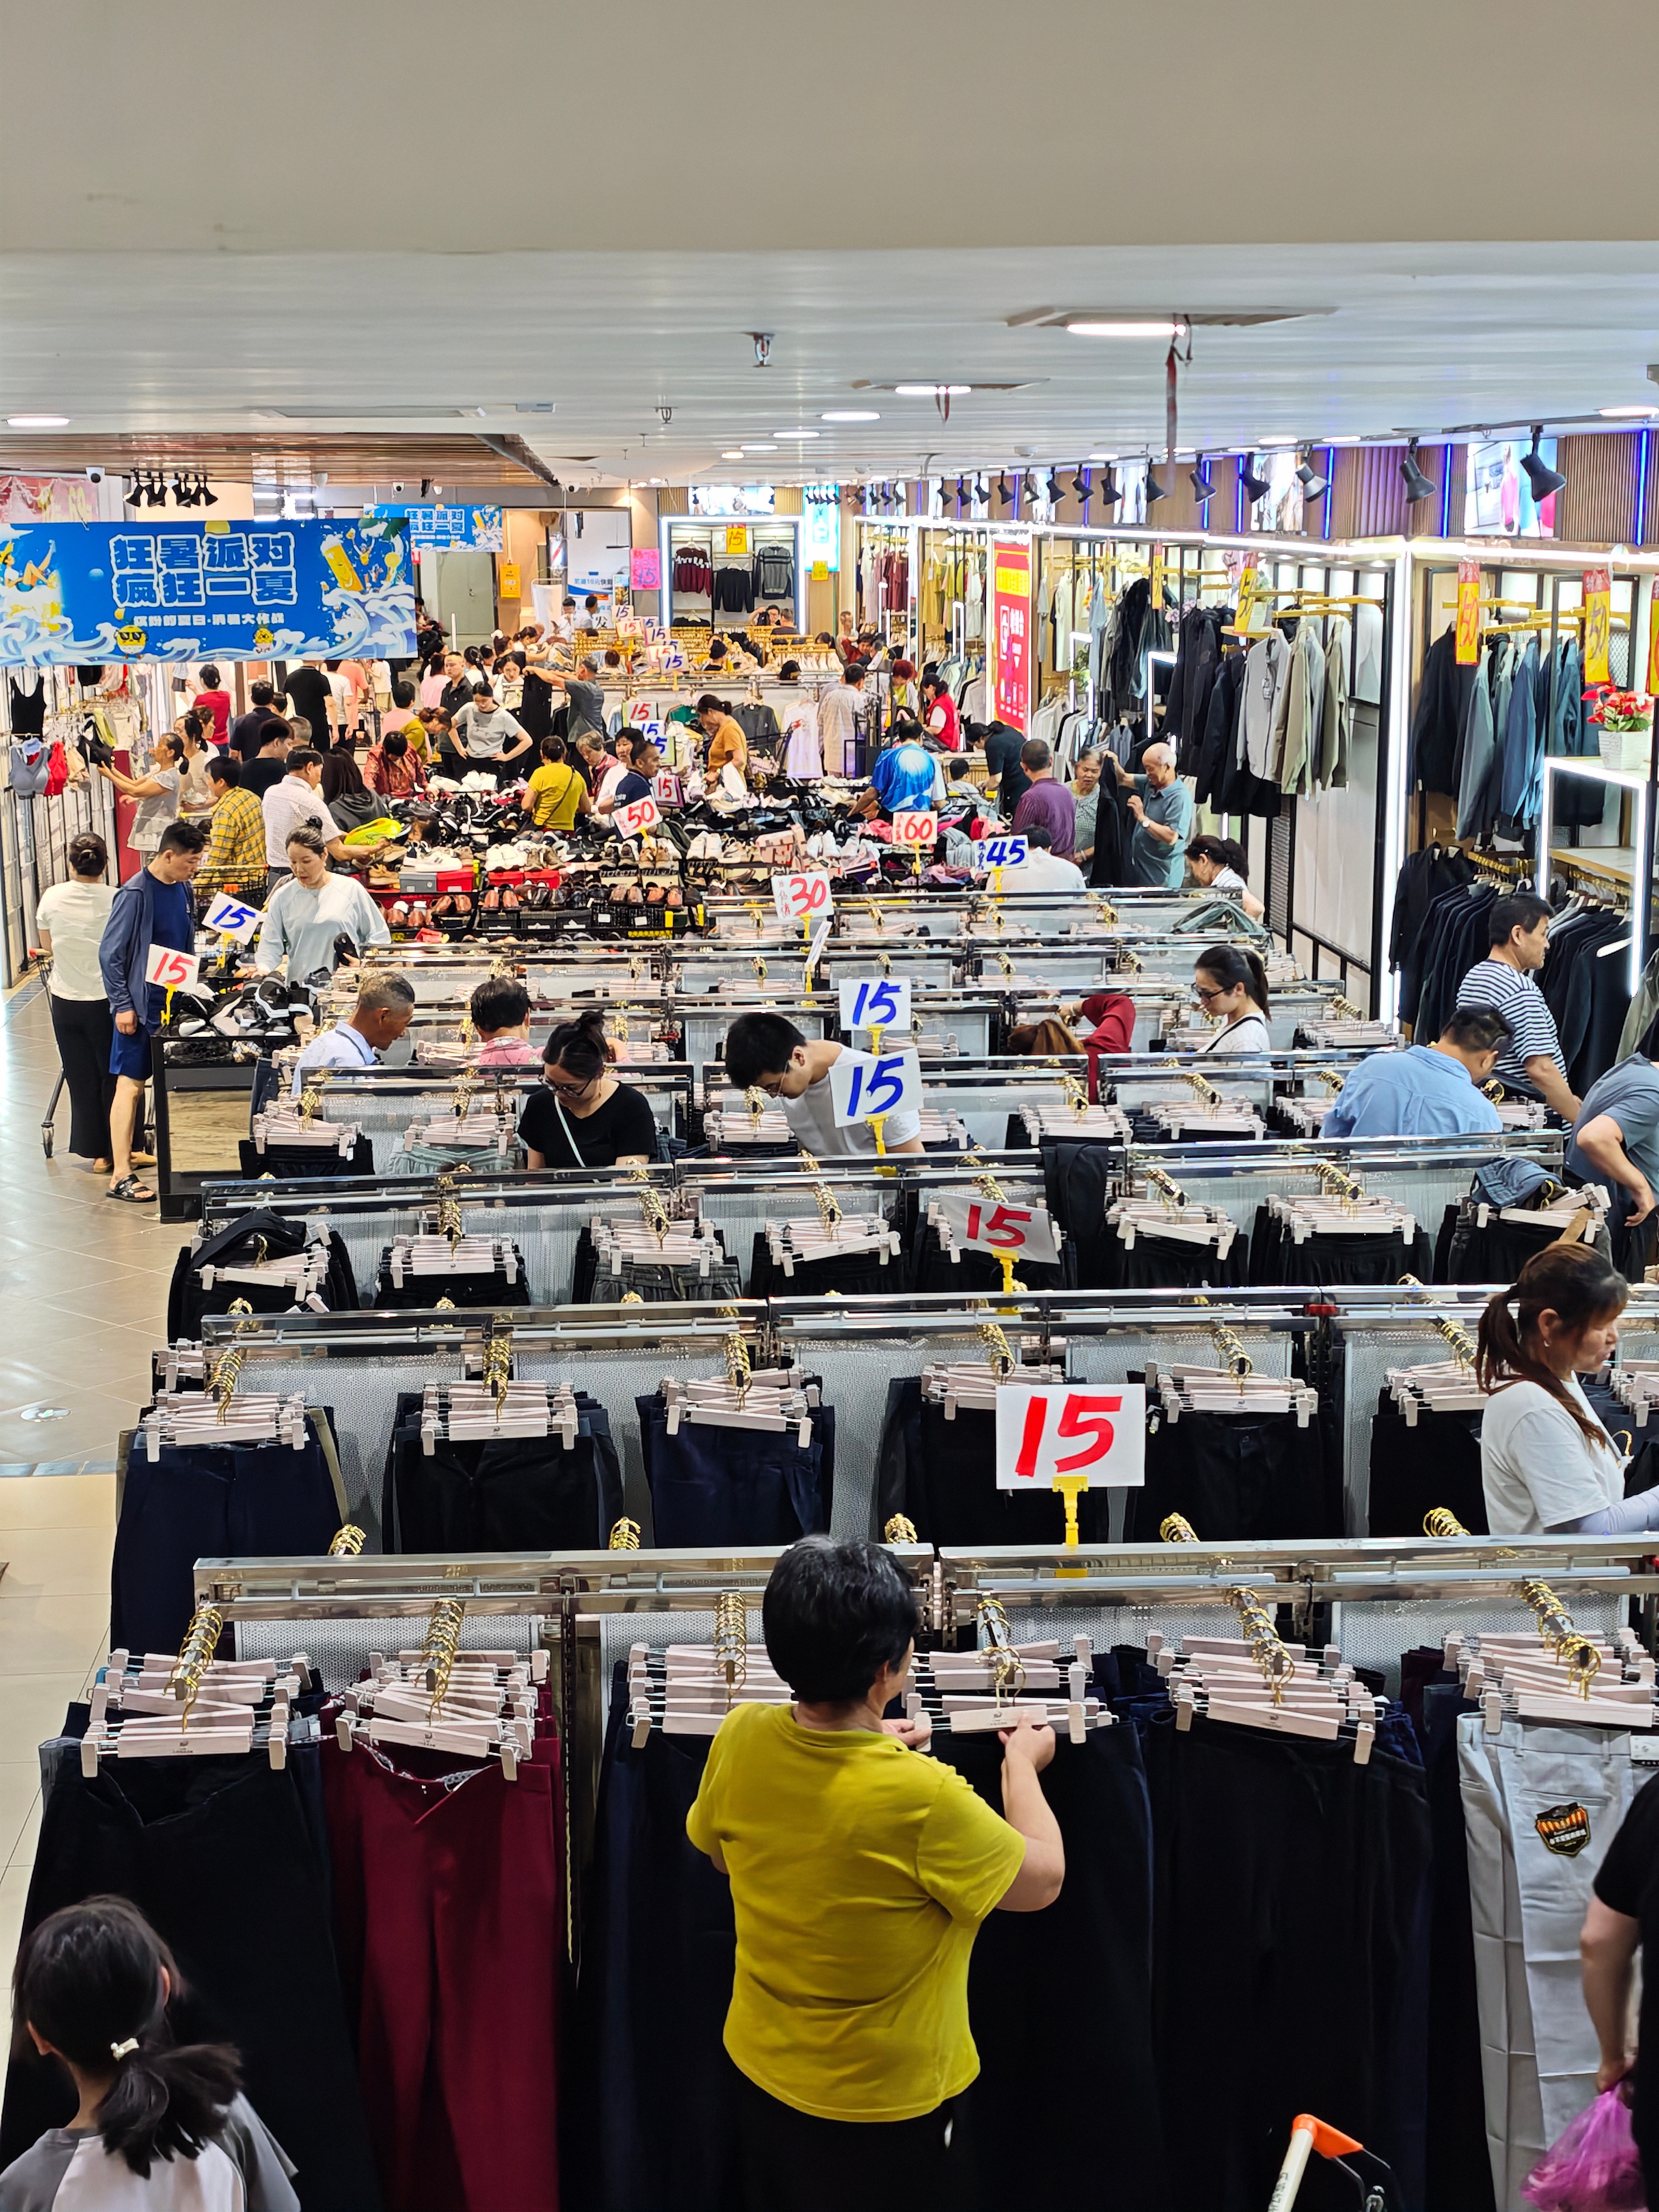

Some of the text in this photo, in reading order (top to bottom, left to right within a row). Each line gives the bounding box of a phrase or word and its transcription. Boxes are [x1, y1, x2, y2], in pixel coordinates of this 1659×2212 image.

[729, 531, 744, 546] 15
[110, 532, 295, 572] 狂暑派对
[112, 570, 298, 607] 疯狂一夏
[638, 568, 657, 585] 15
[616, 607, 629, 618] 15
[624, 623, 636, 632] 15
[652, 628, 665, 642] 15
[665, 655, 683, 669] 15
[630, 703, 651, 720] 15
[658, 778, 672, 798] 15
[628, 801, 655, 829] 50
[905, 814, 933, 840] 60
[986, 839, 1025, 866] 45
[790, 878, 826, 916] 30
[212, 904, 257, 928] 15
[153, 952, 195, 984] 15
[853, 981, 902, 1025] 15
[847, 1057, 905, 1117] 15
[966, 1204, 1031, 1247] 15
[1015, 1393, 1123, 1478] 15
